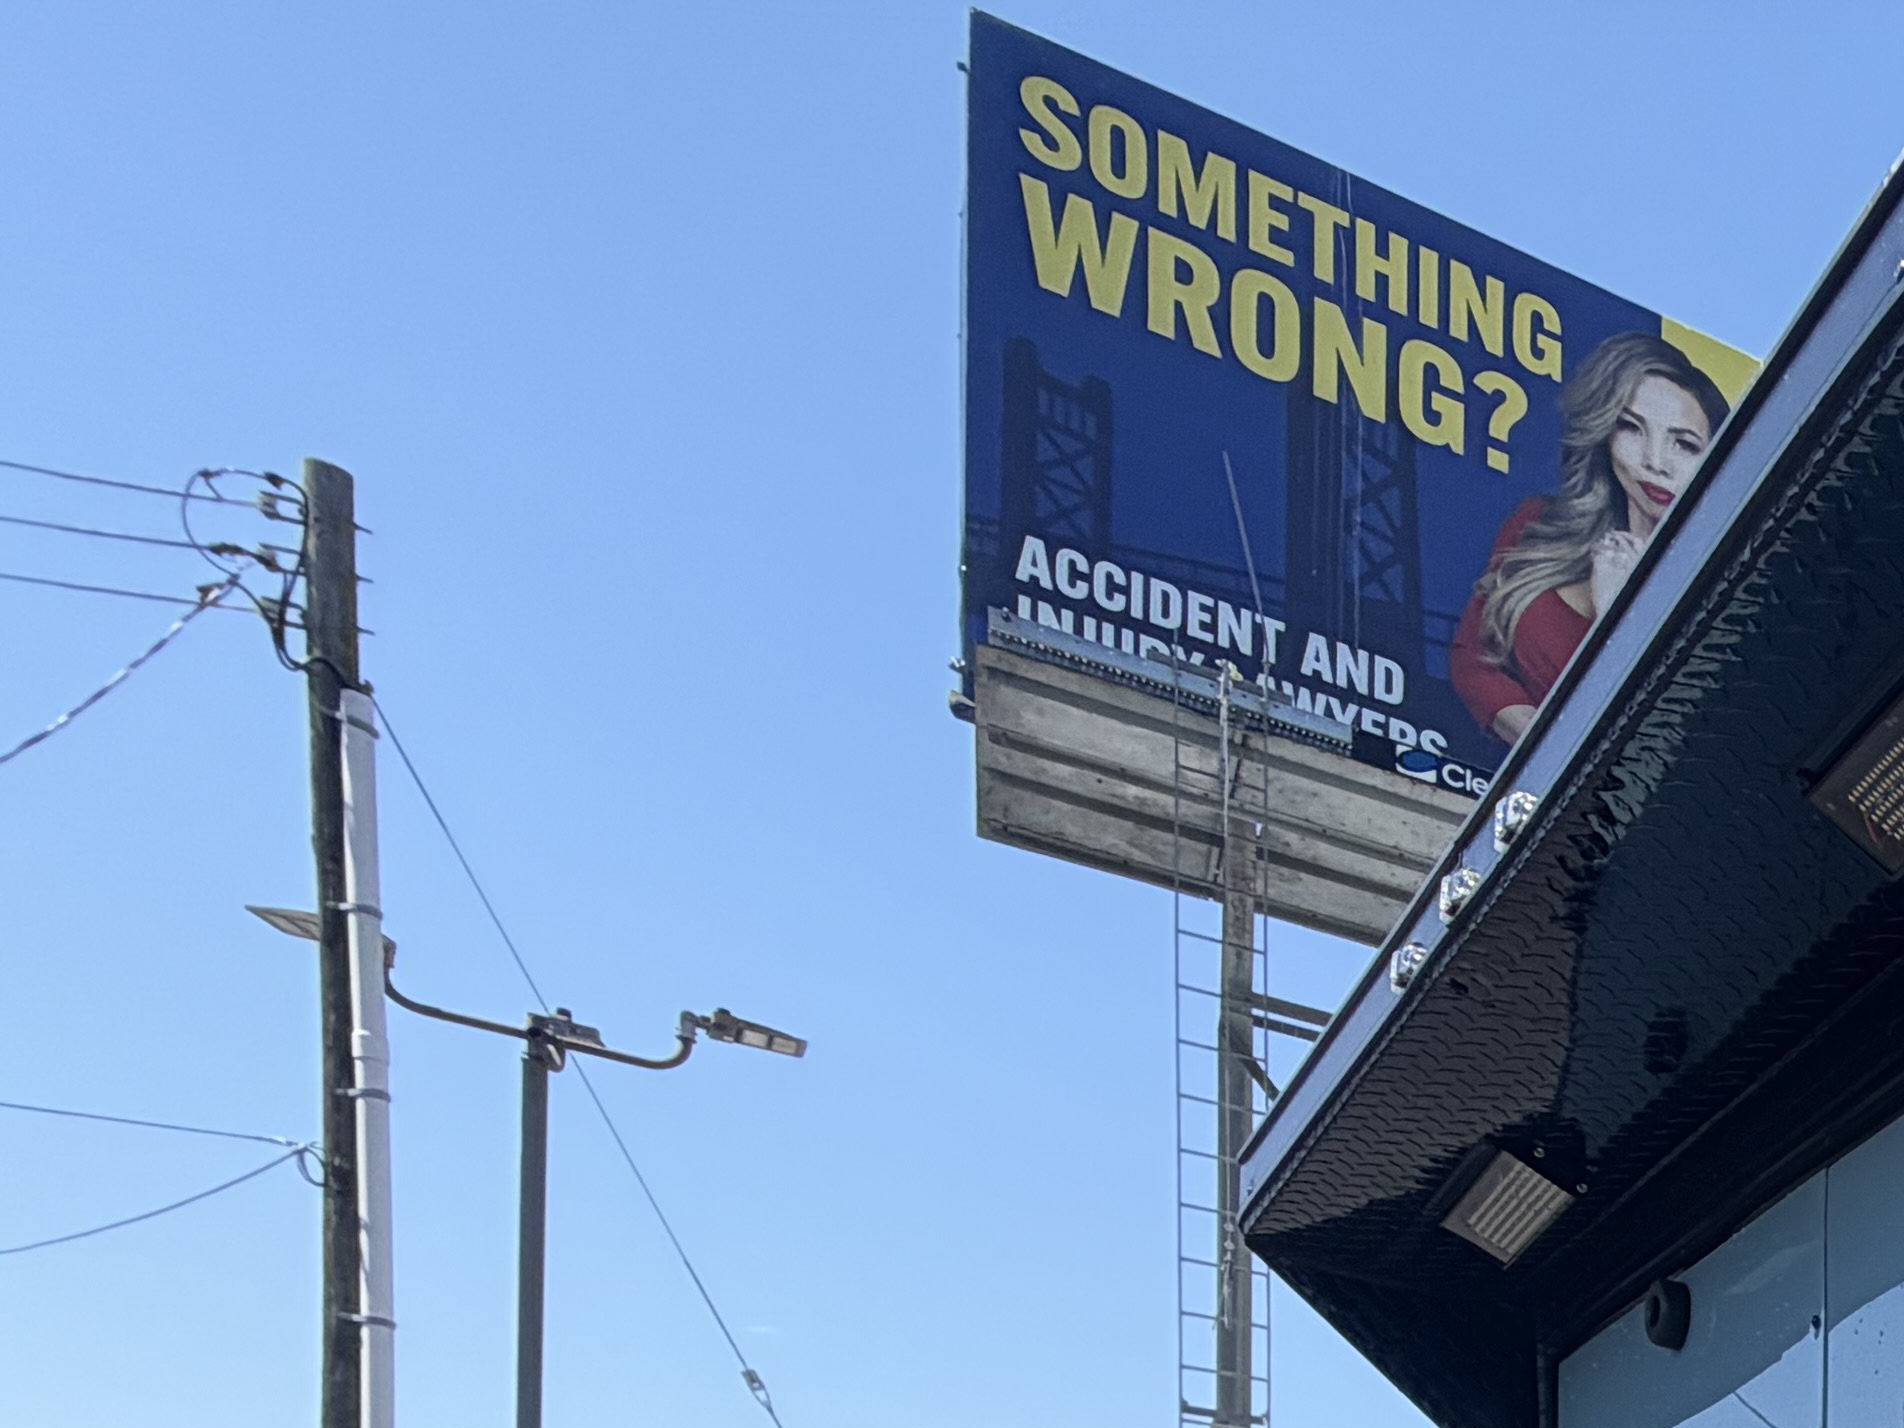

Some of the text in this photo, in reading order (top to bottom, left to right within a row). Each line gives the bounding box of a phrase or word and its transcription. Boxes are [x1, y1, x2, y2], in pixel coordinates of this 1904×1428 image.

[1019, 76, 1562, 382] SOMETHING
[1019, 173, 1528, 474] WRONG?
[1015, 535, 1405, 705] ACCIDENT AND
